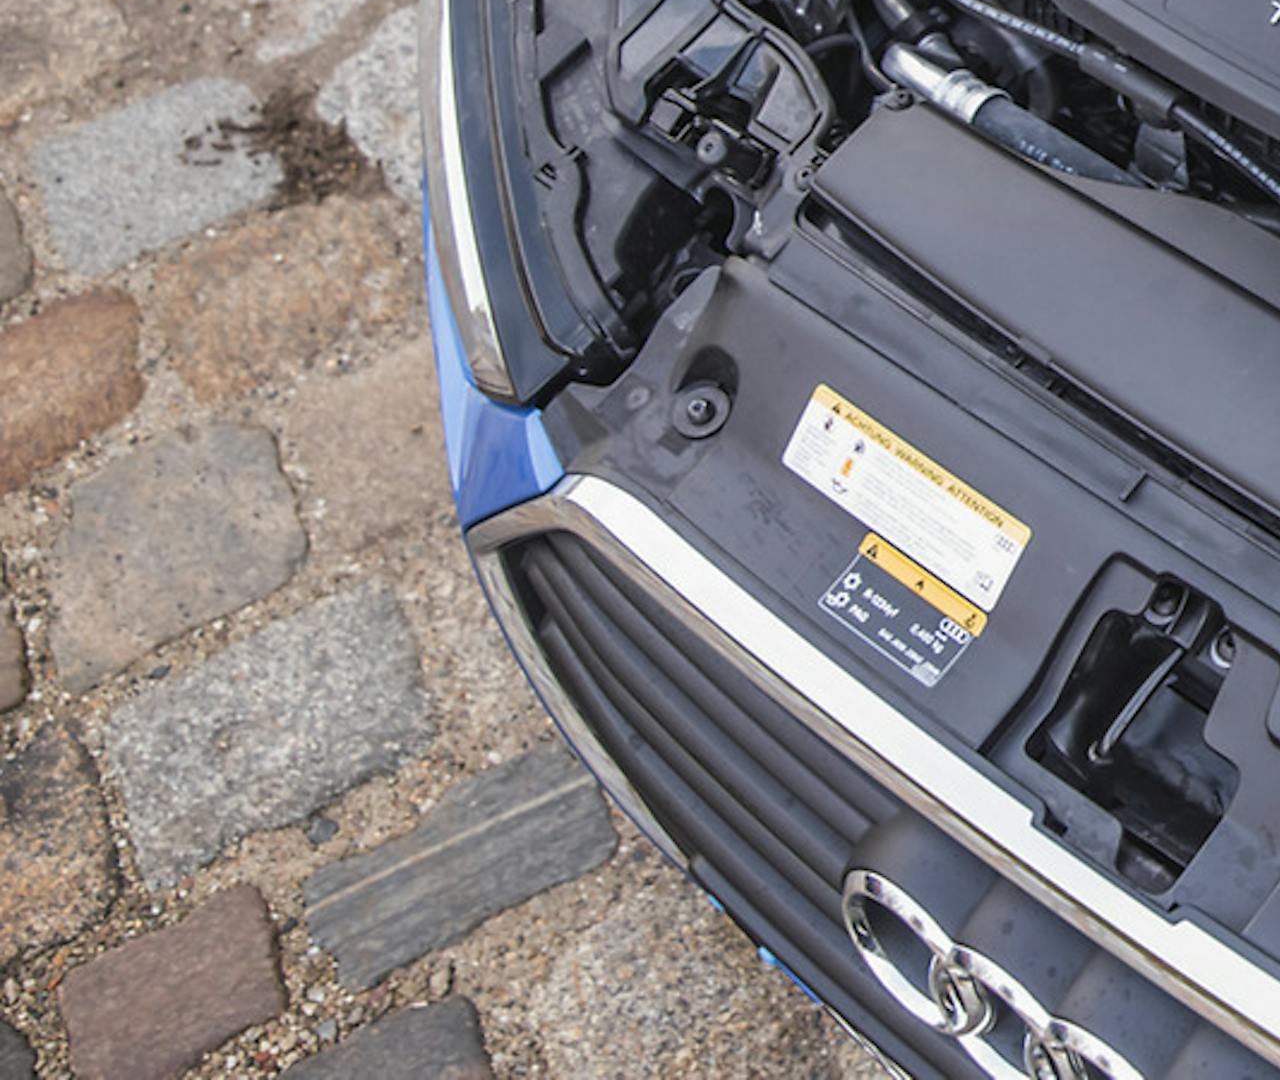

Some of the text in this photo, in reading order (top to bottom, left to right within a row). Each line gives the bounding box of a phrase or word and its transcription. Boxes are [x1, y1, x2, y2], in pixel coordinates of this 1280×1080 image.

[844, 412, 892, 451] ACHTUNG
[894, 446, 945, 487] WARNING
[946, 482, 1005, 528] ATTENTION
